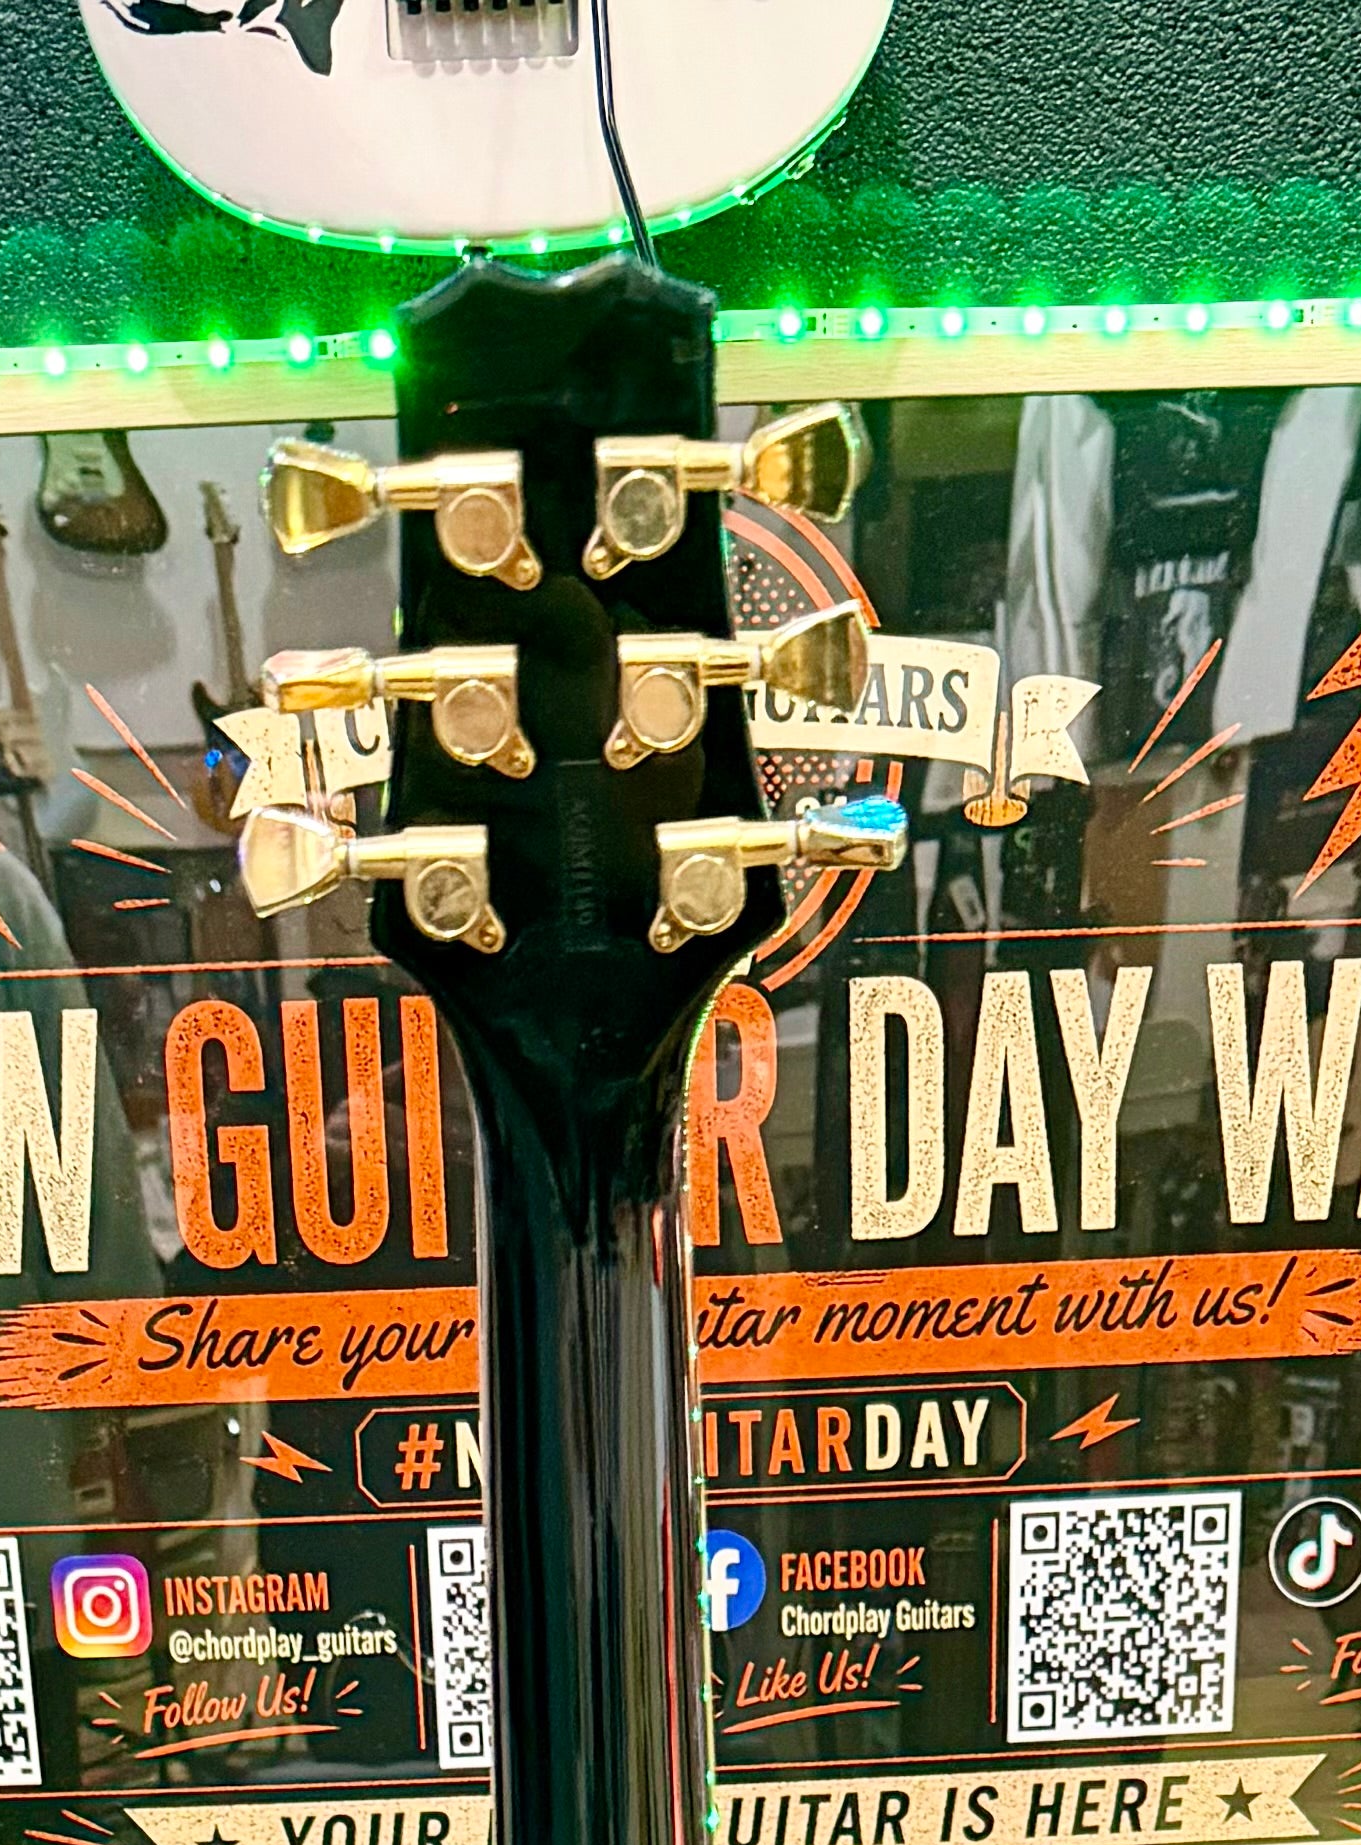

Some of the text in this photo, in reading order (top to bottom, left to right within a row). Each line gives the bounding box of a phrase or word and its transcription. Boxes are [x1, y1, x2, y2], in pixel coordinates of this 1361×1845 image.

[165, 986, 784, 1271] GUIR
[847, 965, 1153, 1241] DAY
[136, 1254, 1297, 1389] Share your itar moment with us!
[163, 1571, 330, 1618] INSTAGRAM
[779, 1548, 926, 1594] FACEBOOK
[168, 1626, 398, 1666] @chordplay_guitars
[781, 1598, 975, 1639] Chordplay Guitars
[142, 1669, 314, 1733] Follow Us!
[734, 1642, 878, 1704] Like Us!
[939, 1783, 996, 1844] IS
[1025, 1773, 1190, 1838] HERE
